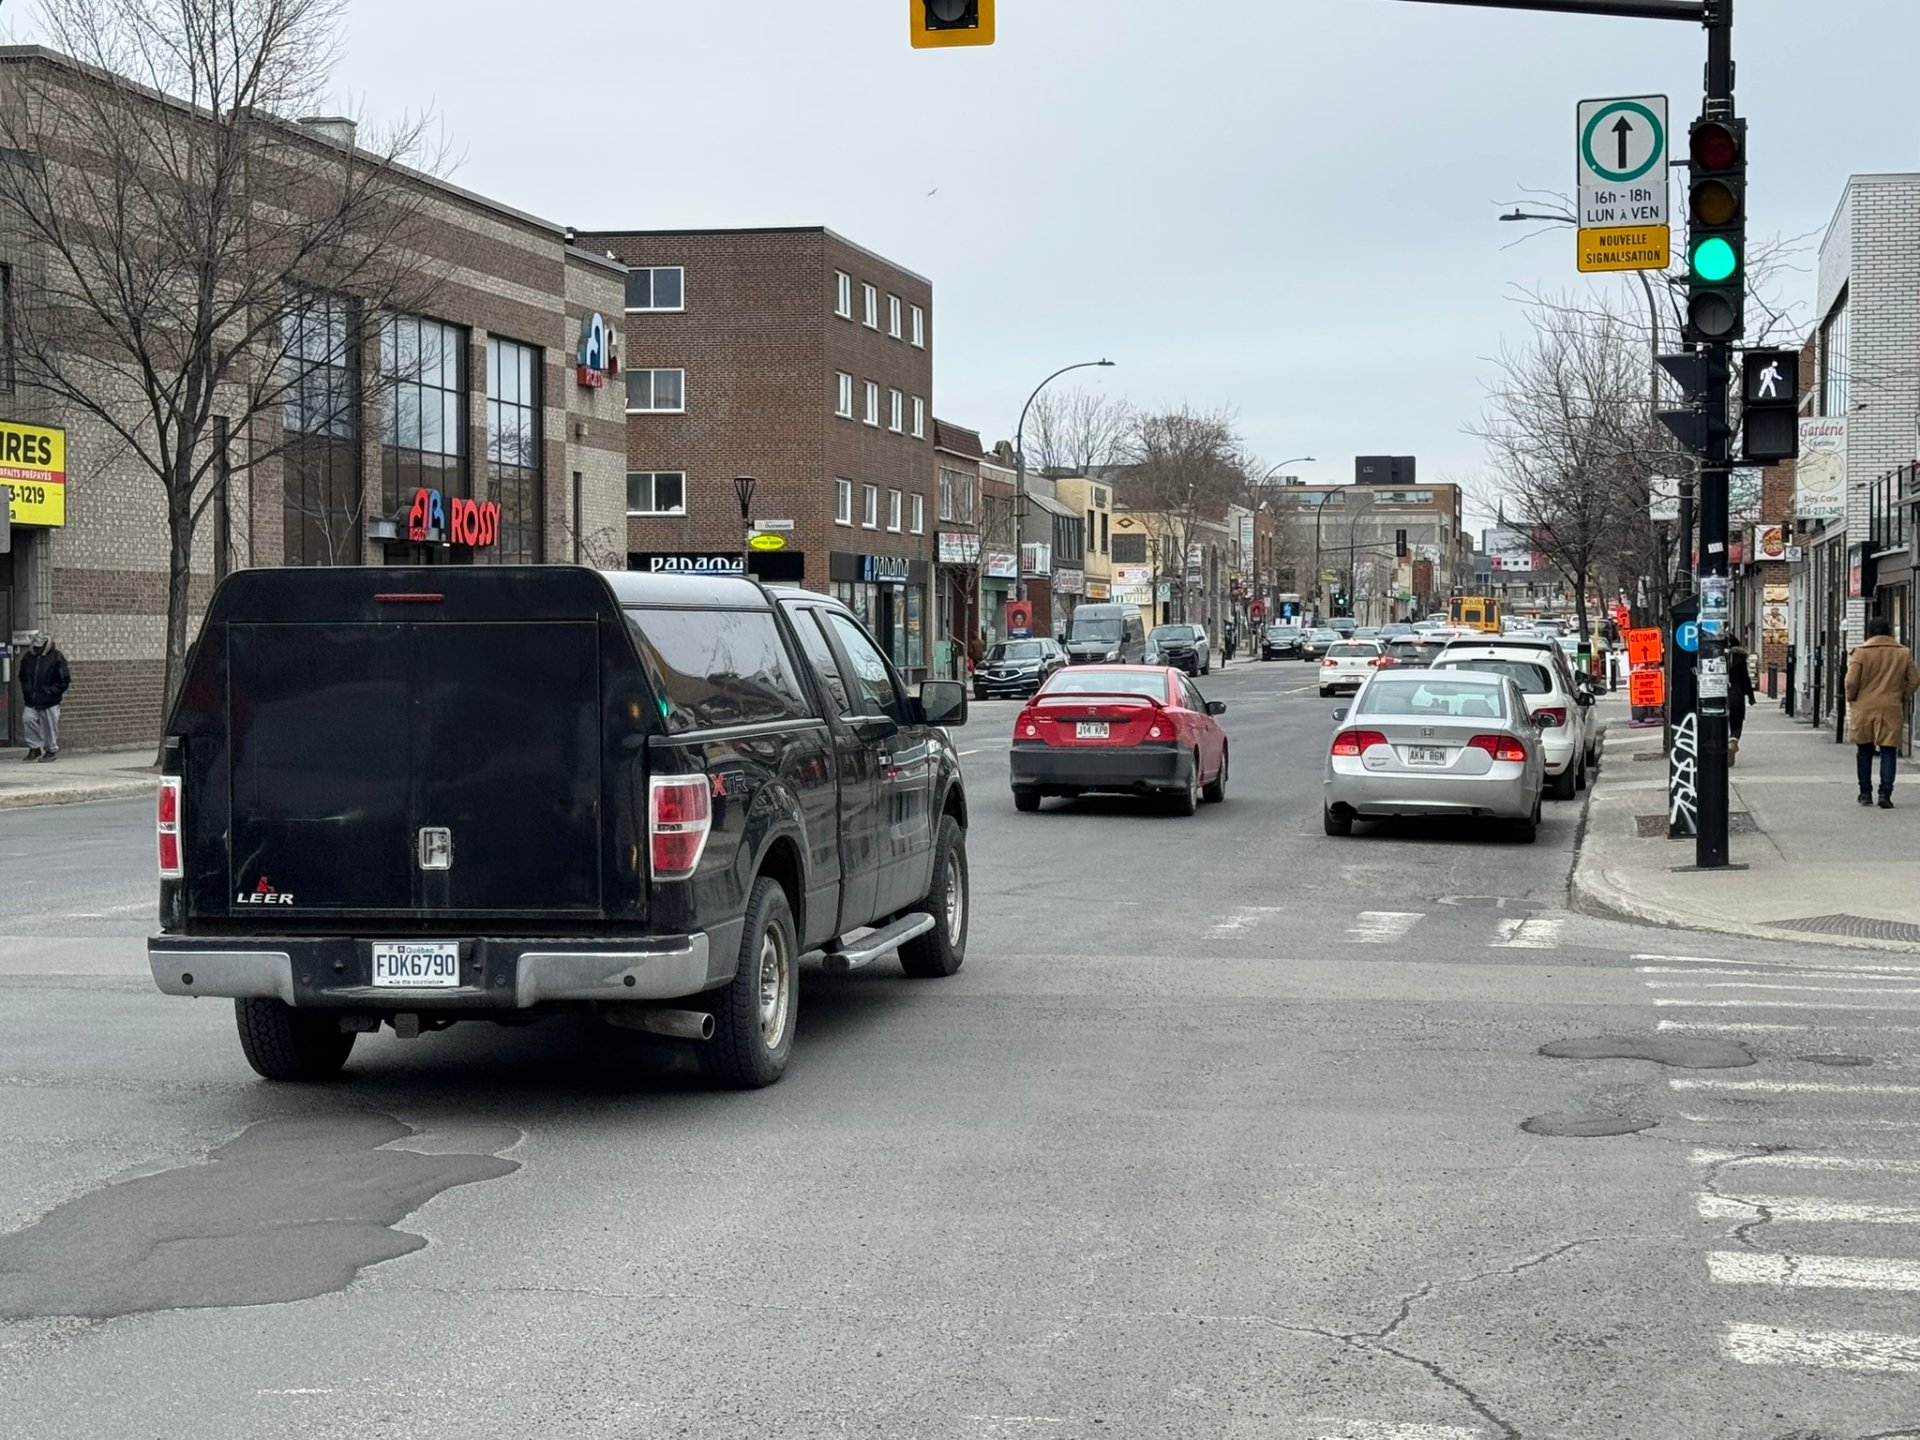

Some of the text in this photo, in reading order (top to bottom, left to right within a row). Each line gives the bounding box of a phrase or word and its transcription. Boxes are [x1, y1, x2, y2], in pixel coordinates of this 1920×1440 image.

[1595, 191, 1616, 204] 16h
[1630, 188, 1651, 202] 18h
[1587, 208, 1614, 222] LUN
[1631, 206, 1659, 219] VEN
[1599, 234, 1647, 247] NOUVELLE
[1586, 249, 1661, 264] SIGNALISATION
[1800, 420, 1844, 438] Garderie
[451, 495, 501, 546] ROSSY
[650, 557, 744, 573] panama
[873, 556, 909, 581] panama
[1684, 626, 1698, 646] P
[237, 893, 294, 905] LEER
[406, 946, 435, 954] Québec
[376, 954, 456, 976] FDK6790
